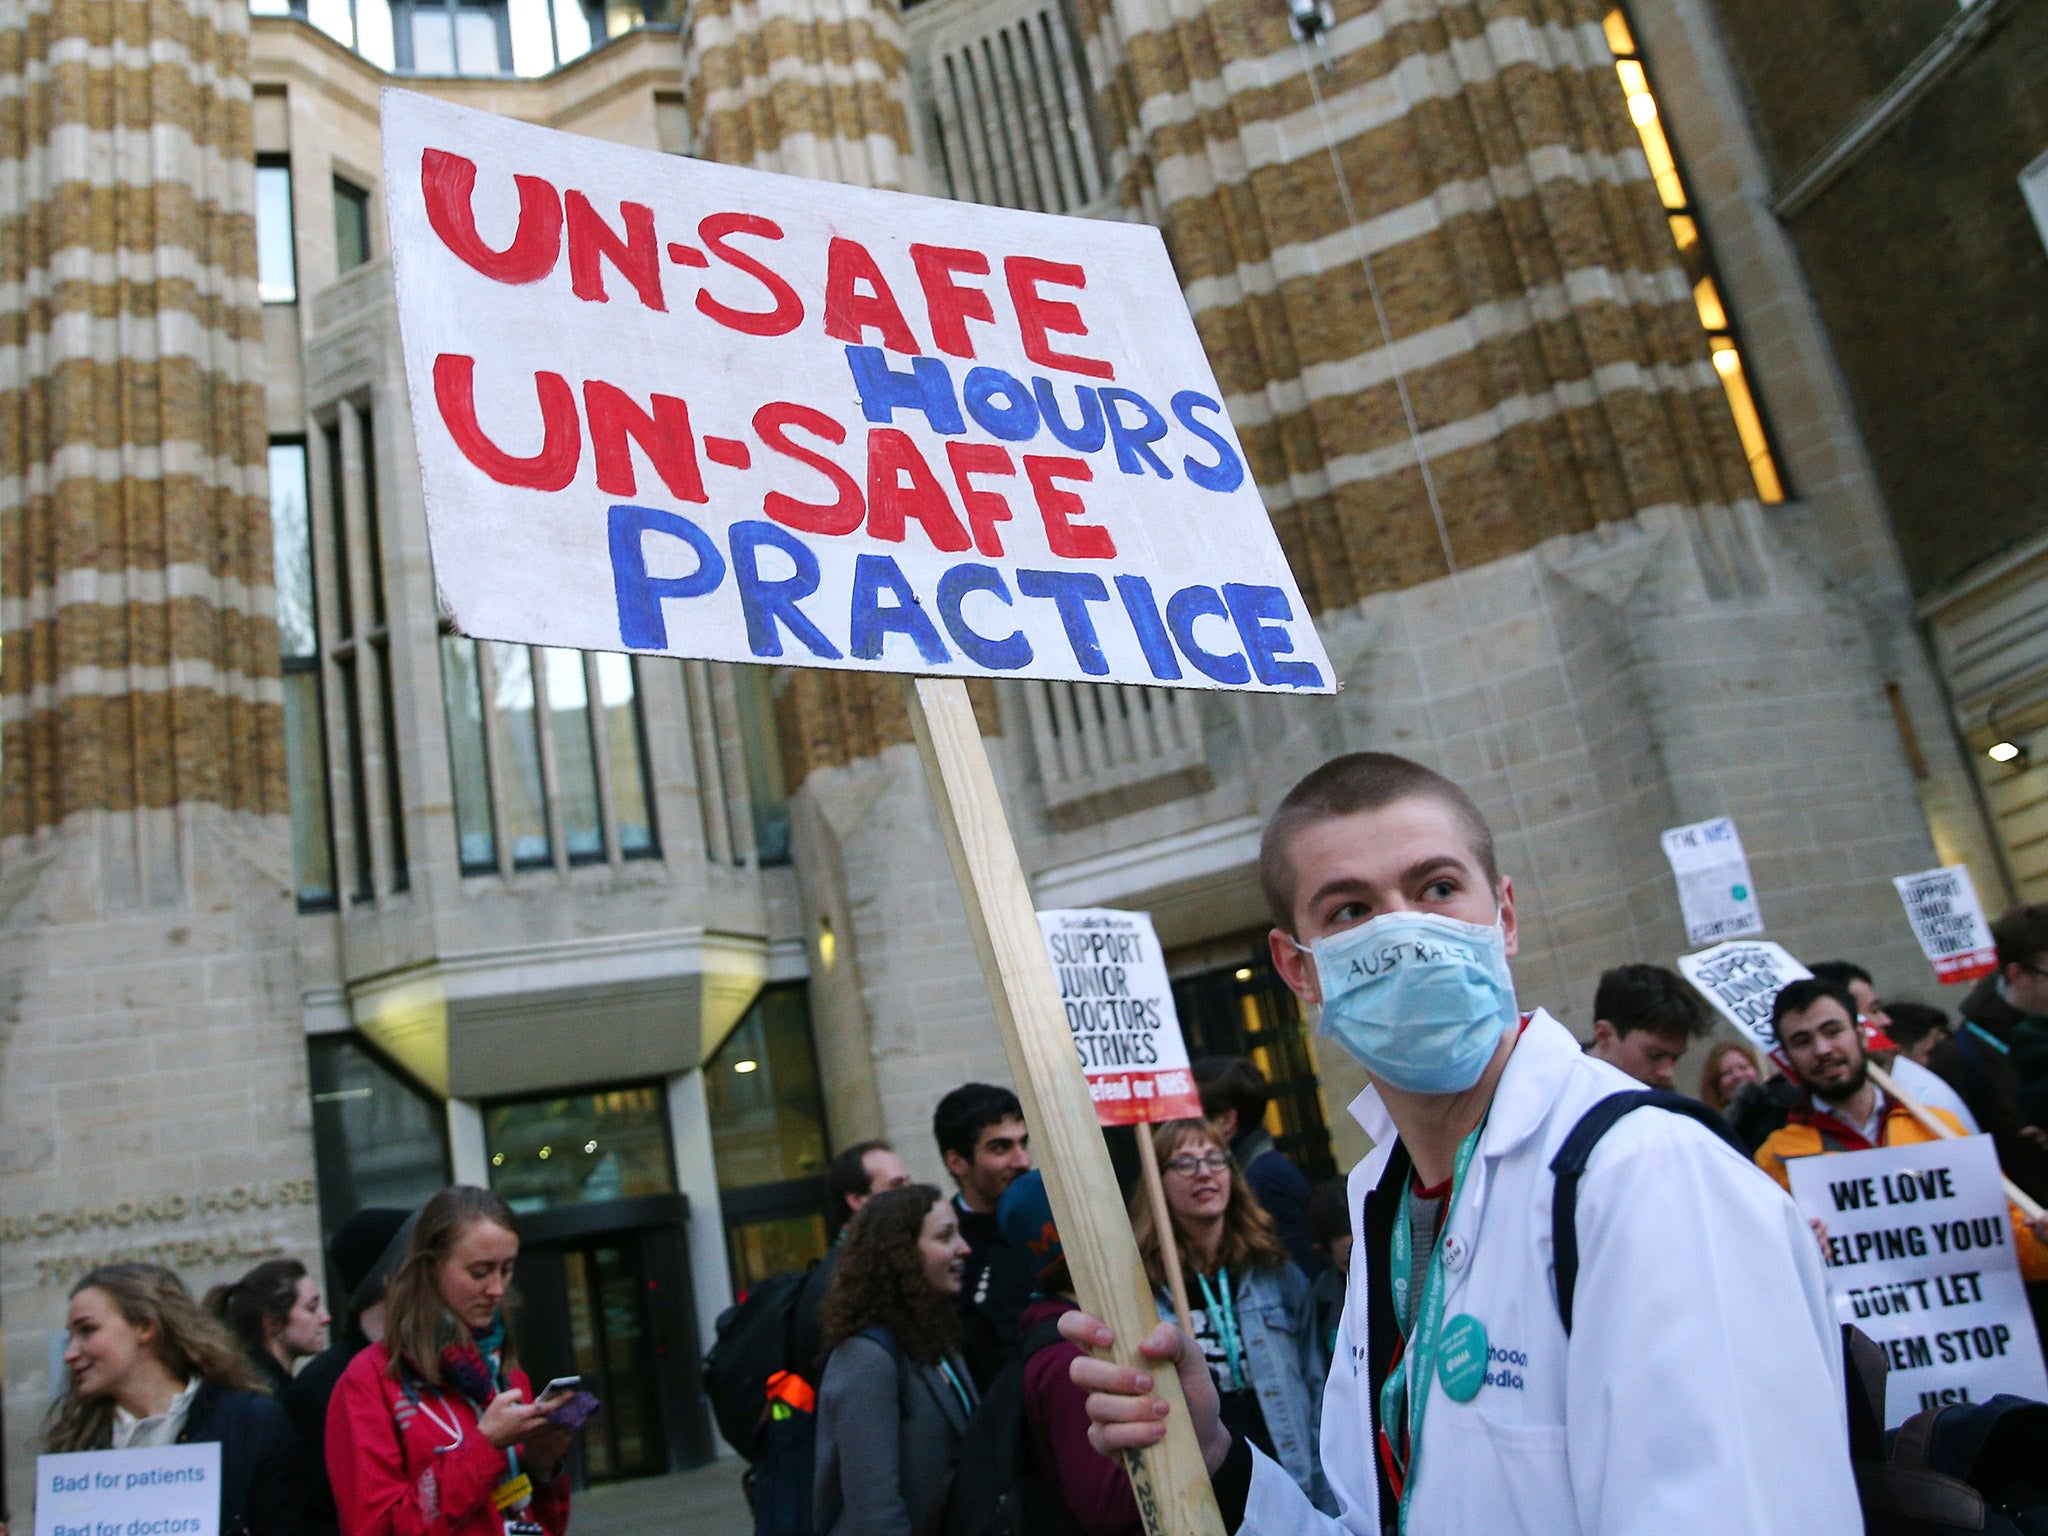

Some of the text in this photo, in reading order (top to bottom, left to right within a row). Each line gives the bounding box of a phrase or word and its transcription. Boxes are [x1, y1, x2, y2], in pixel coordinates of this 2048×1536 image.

[420, 146, 1115, 381] UN-SAFE
[844, 343, 1244, 493] HOURS
[432, 352, 1118, 561] UN-SAFE
[607, 503, 1324, 688] PRACTICE
[1050, 933, 1144, 964] SUPPORT
[1059, 965, 1130, 998] JUNIOR
[1073, 1033, 1158, 1067] STRIKES
[1089, 1075, 1131, 1101] efend
[1829, 1167, 1955, 1212] WE LOVE
[1827, 1216, 2003, 1267] ELPING YOU!
[1848, 1270, 1982, 1319] DON'T LET
[1936, 1324, 2010, 1364] STOP
[52, 1466, 205, 1493] Bad for patients
[54, 1517, 201, 1536] Bad for doctors
